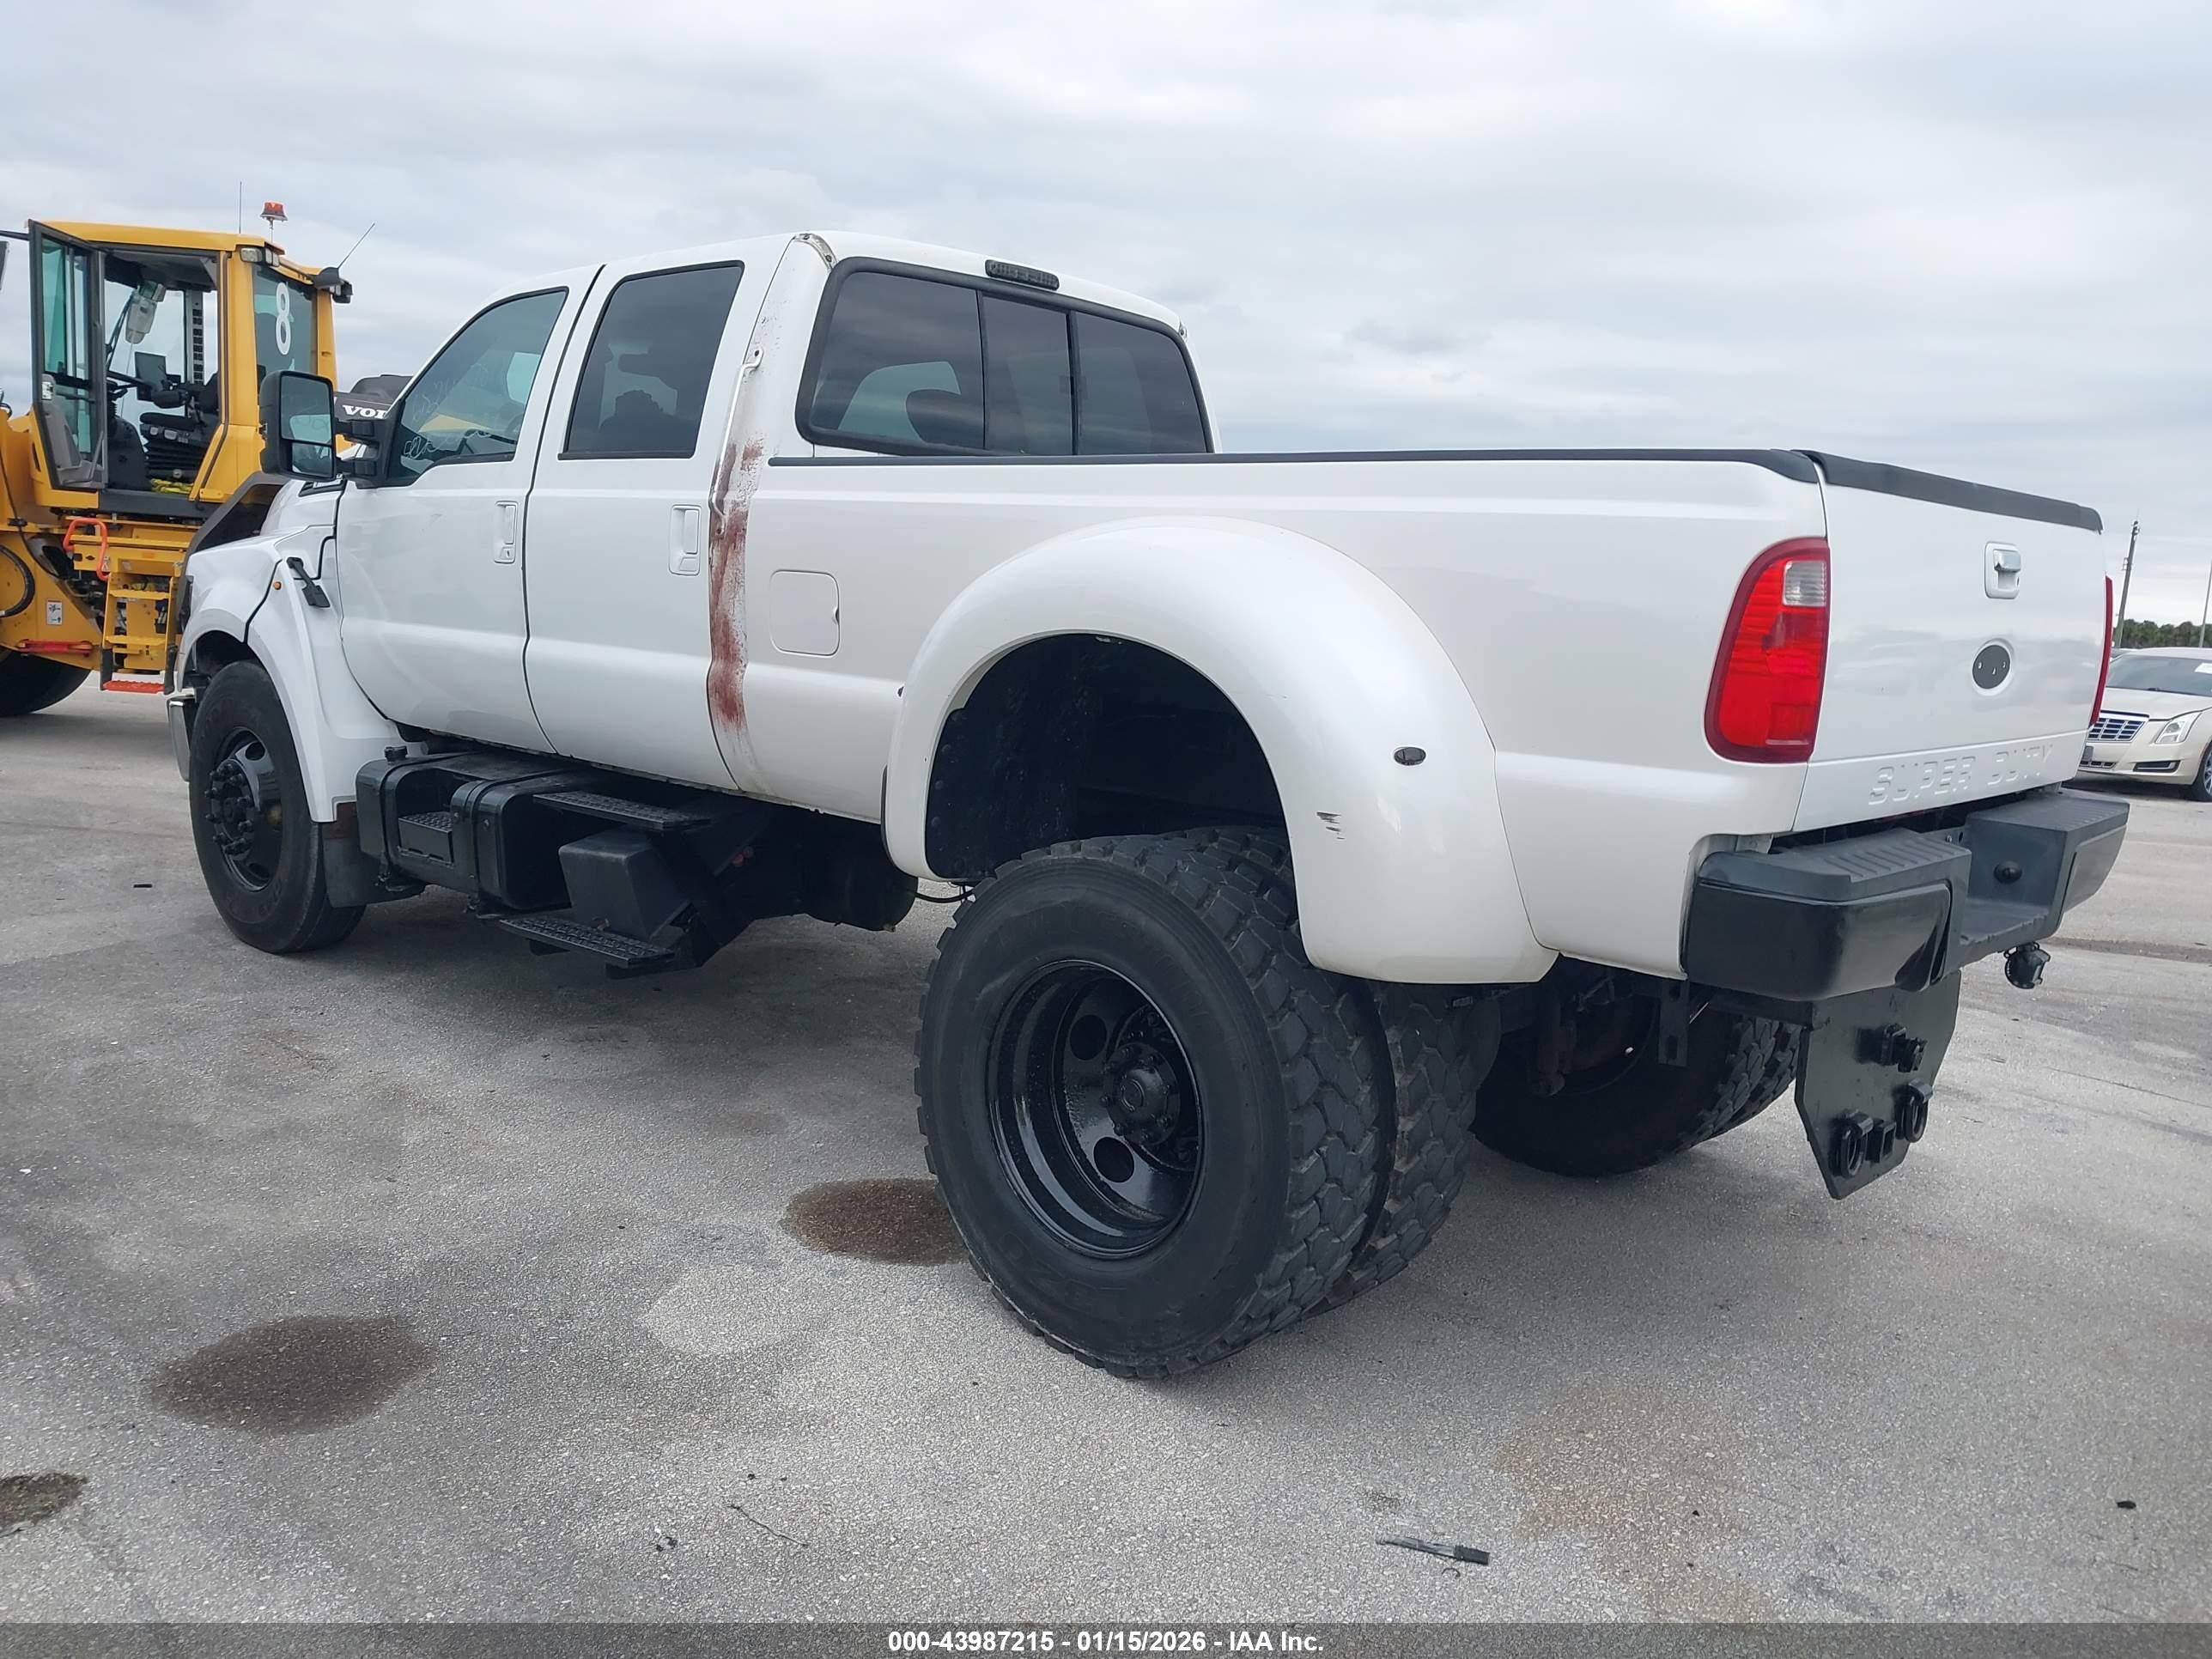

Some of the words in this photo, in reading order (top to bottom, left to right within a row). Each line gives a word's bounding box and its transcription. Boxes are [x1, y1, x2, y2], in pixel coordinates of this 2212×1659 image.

[276, 282, 291, 356] 8
[1867, 756, 1977, 806] SUPER
[1986, 744, 2054, 787] DUTY
